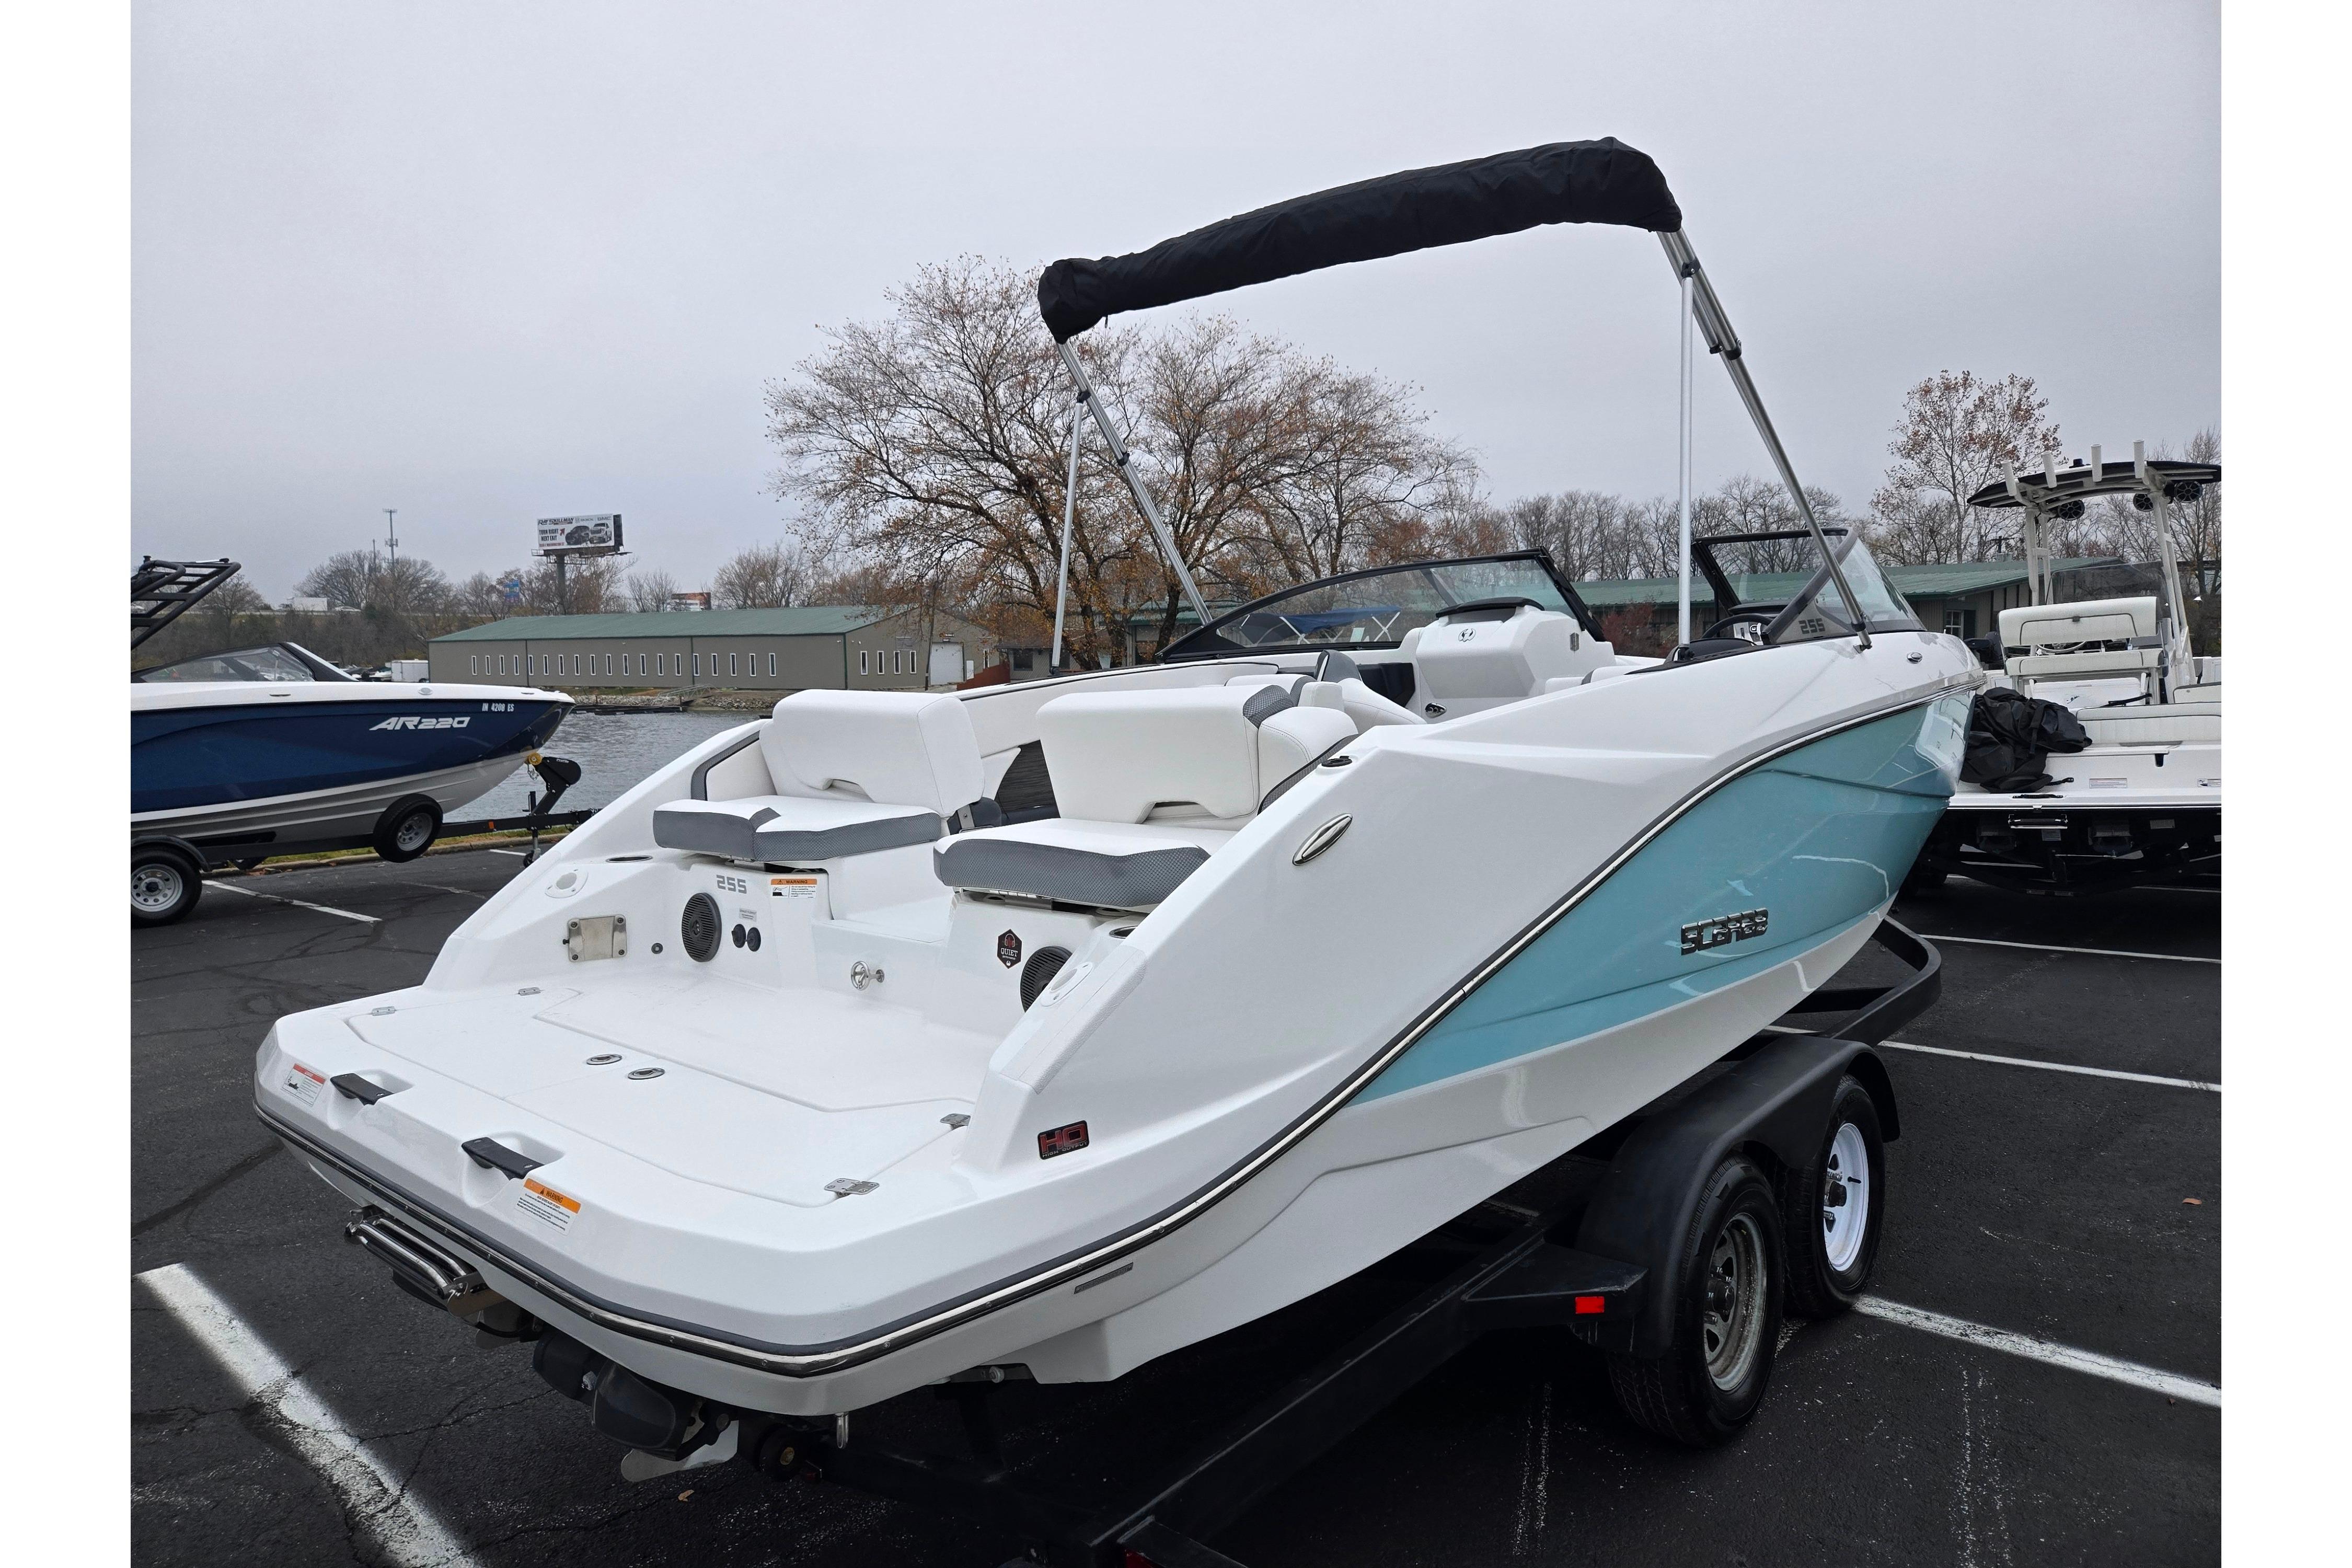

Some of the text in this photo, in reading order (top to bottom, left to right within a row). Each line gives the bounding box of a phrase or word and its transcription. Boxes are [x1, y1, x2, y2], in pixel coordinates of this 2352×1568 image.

[1798, 618, 1826, 635] 255
[482, 702, 514, 712] IN 4208 ES
[369, 716, 471, 731] AR220
[716, 874, 747, 894] 255
[1001, 948, 1018, 957] QUIET
[1040, 1123, 1088, 1155] HO
[1062, 1142, 1088, 1151] OUTPUT
[545, 1190, 563, 1203] WARNING
